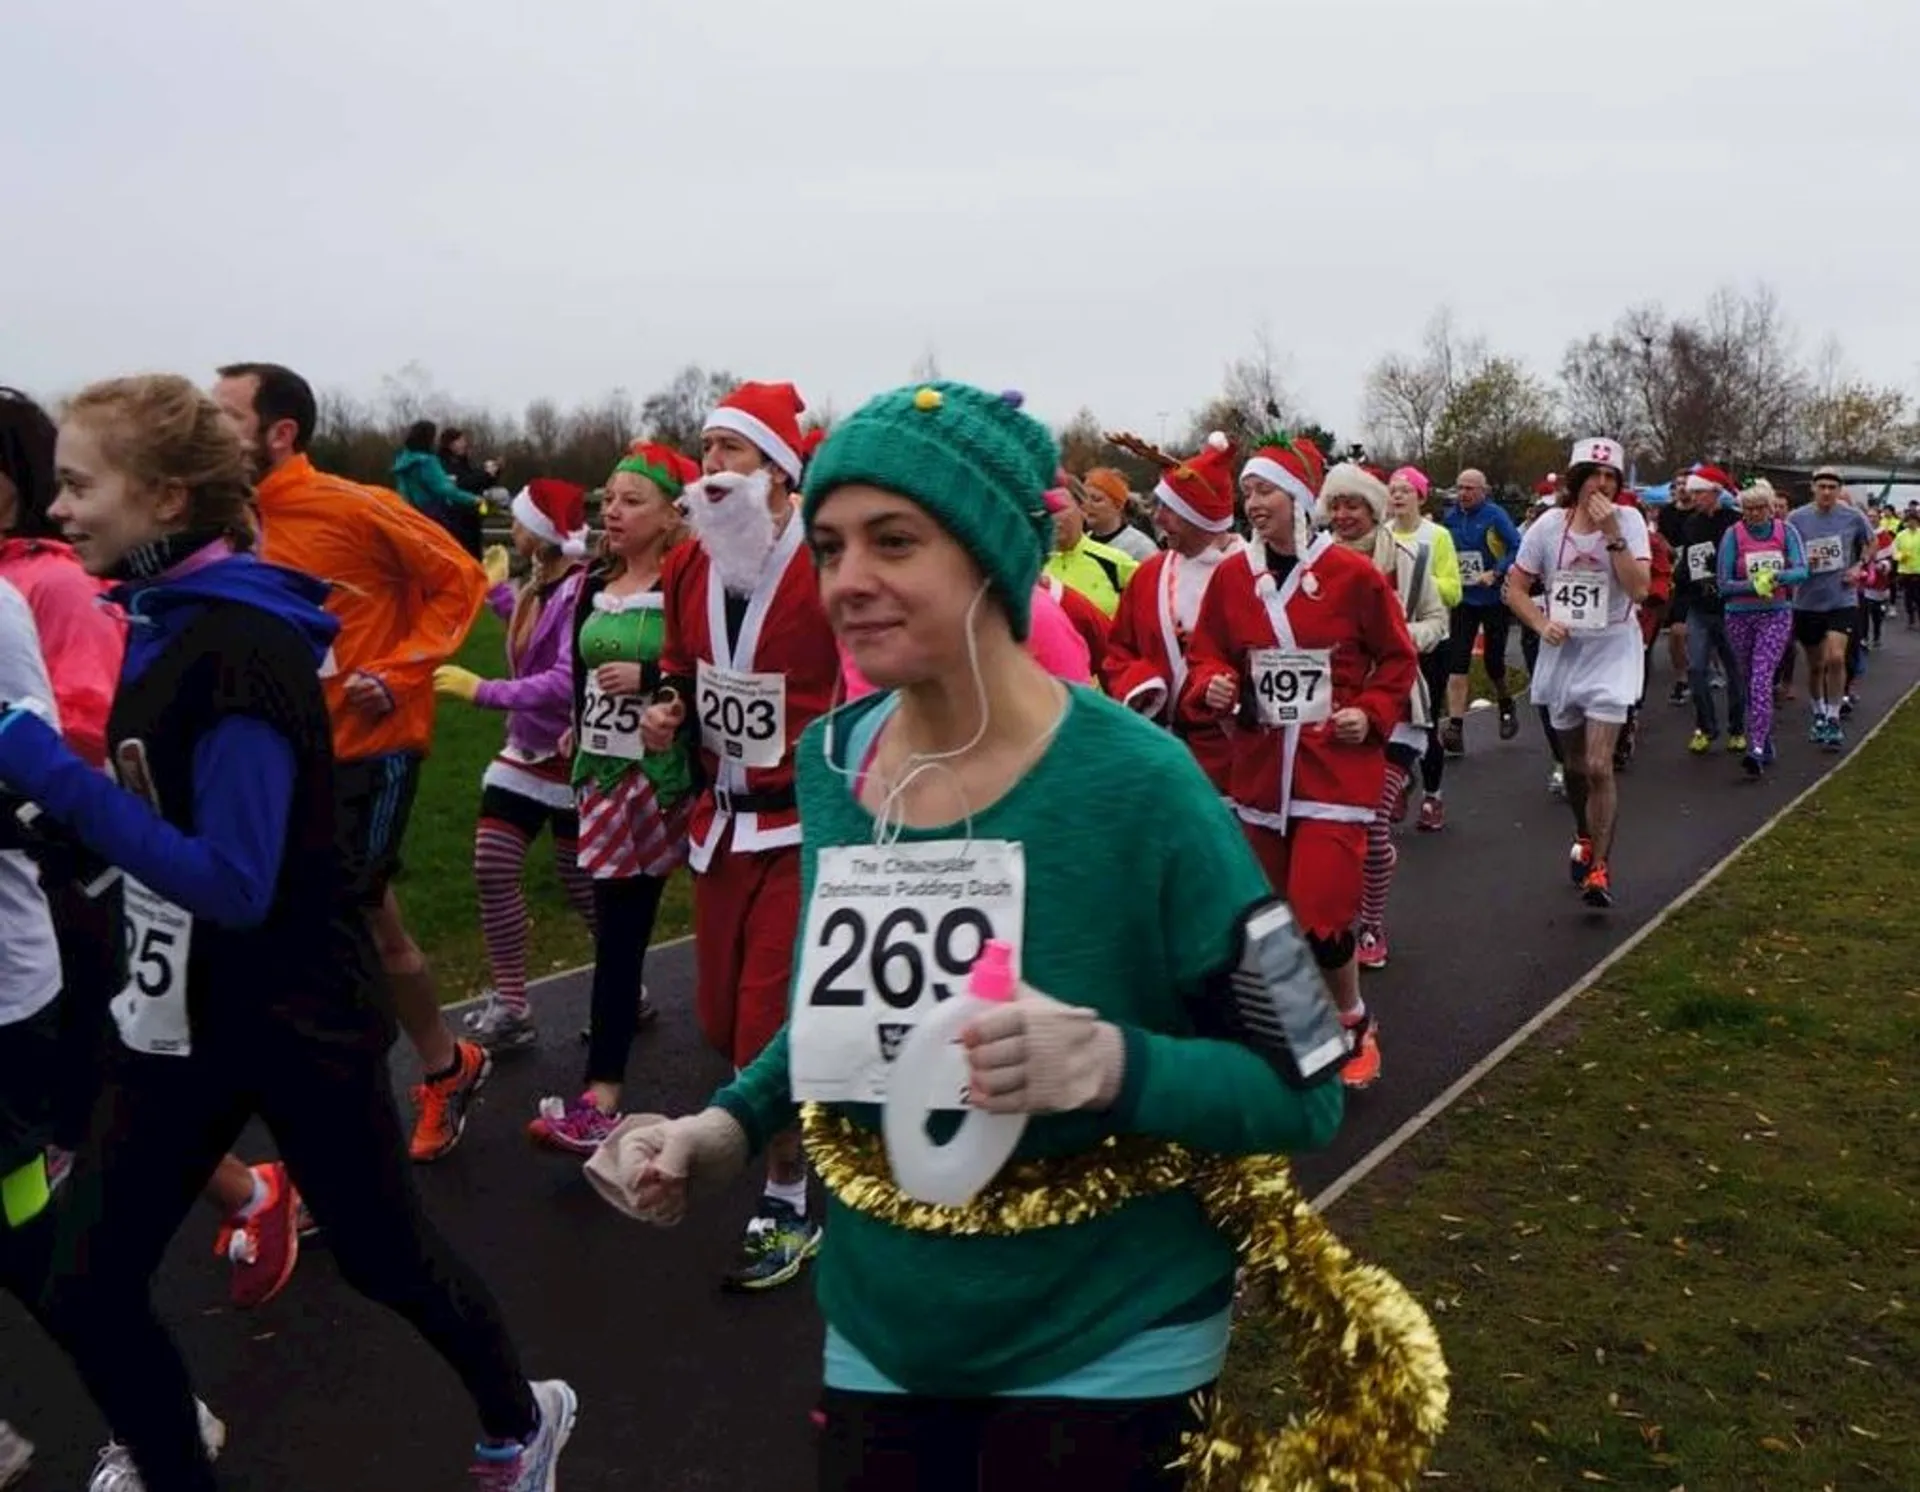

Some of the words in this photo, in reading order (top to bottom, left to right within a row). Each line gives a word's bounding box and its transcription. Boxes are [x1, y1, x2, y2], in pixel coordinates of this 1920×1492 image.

[1555, 584, 1600, 609] 451
[1259, 669, 1322, 703] 497
[703, 689, 777, 740] 203
[810, 907, 994, 1008] 269
